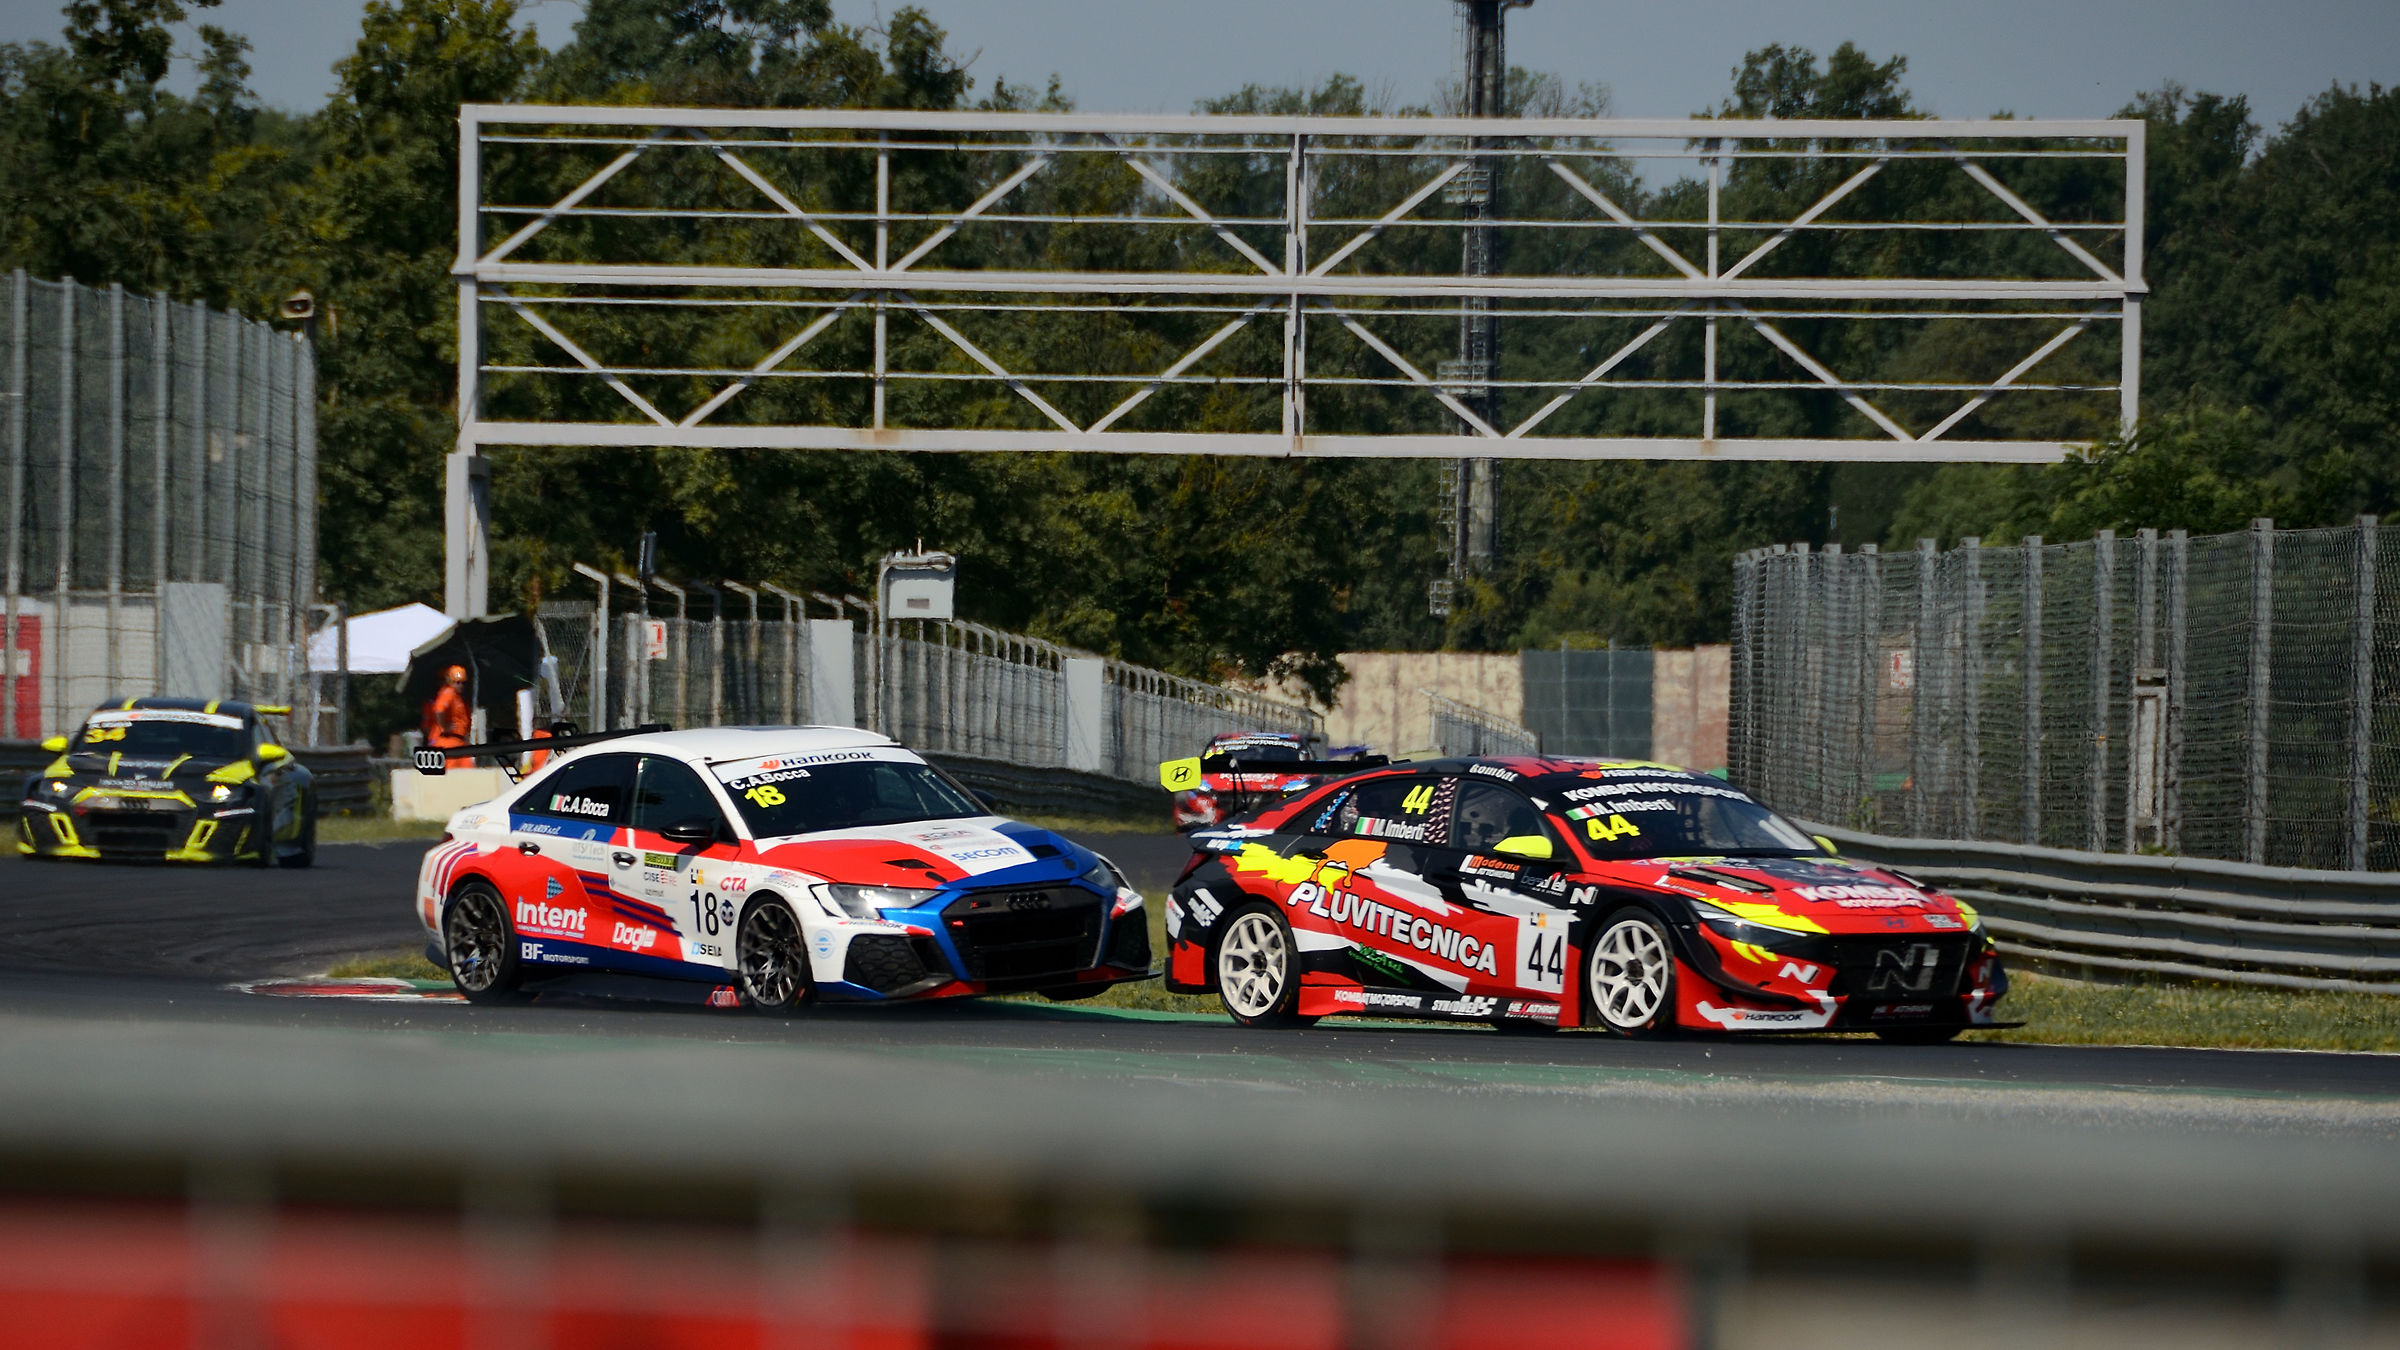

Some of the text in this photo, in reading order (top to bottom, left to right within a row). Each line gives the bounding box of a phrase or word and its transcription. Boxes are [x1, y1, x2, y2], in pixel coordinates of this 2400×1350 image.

[744, 785, 786, 809] 18
[1401, 785, 1434, 815] 44
[1613, 799, 1676, 813] Imberti
[1385, 819, 1426, 841] Imberti
[1586, 814, 1641, 841] 44
[720, 877, 747, 891] CTA
[1792, 885, 1933, 904] KOMBAT
[516, 896, 588, 931] intent
[690, 889, 719, 936] 18
[1287, 881, 1498, 977] PLUVITECNICA
[521, 942, 544, 960] BF
[1528, 933, 1563, 984] 44
